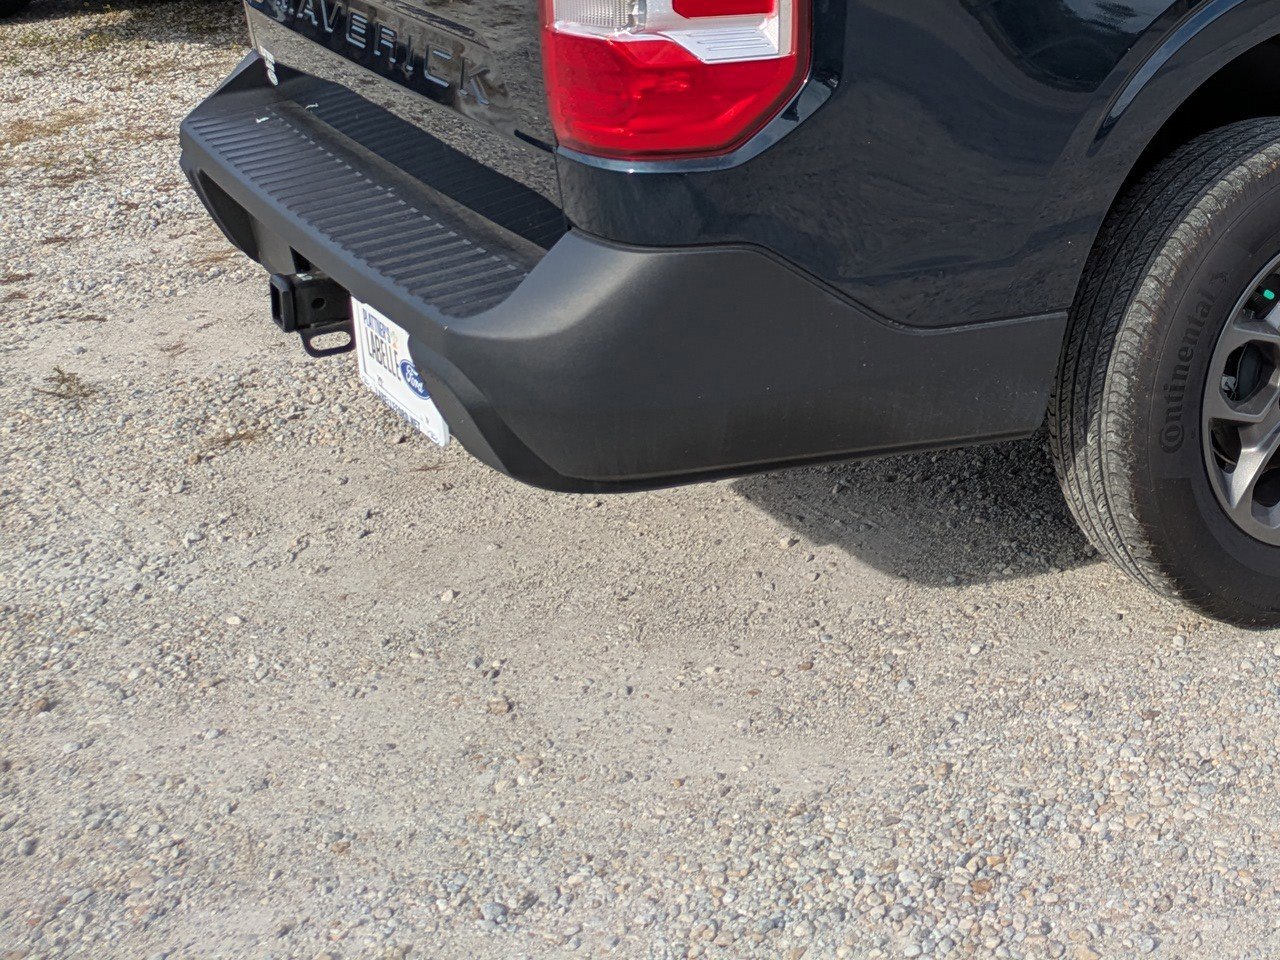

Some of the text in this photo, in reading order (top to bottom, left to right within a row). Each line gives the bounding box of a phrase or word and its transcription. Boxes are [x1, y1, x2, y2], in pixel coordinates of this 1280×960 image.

[365, 326, 402, 382] LABELLE
[404, 364, 425, 394] Ford
[1159, 291, 1216, 454] Continental
